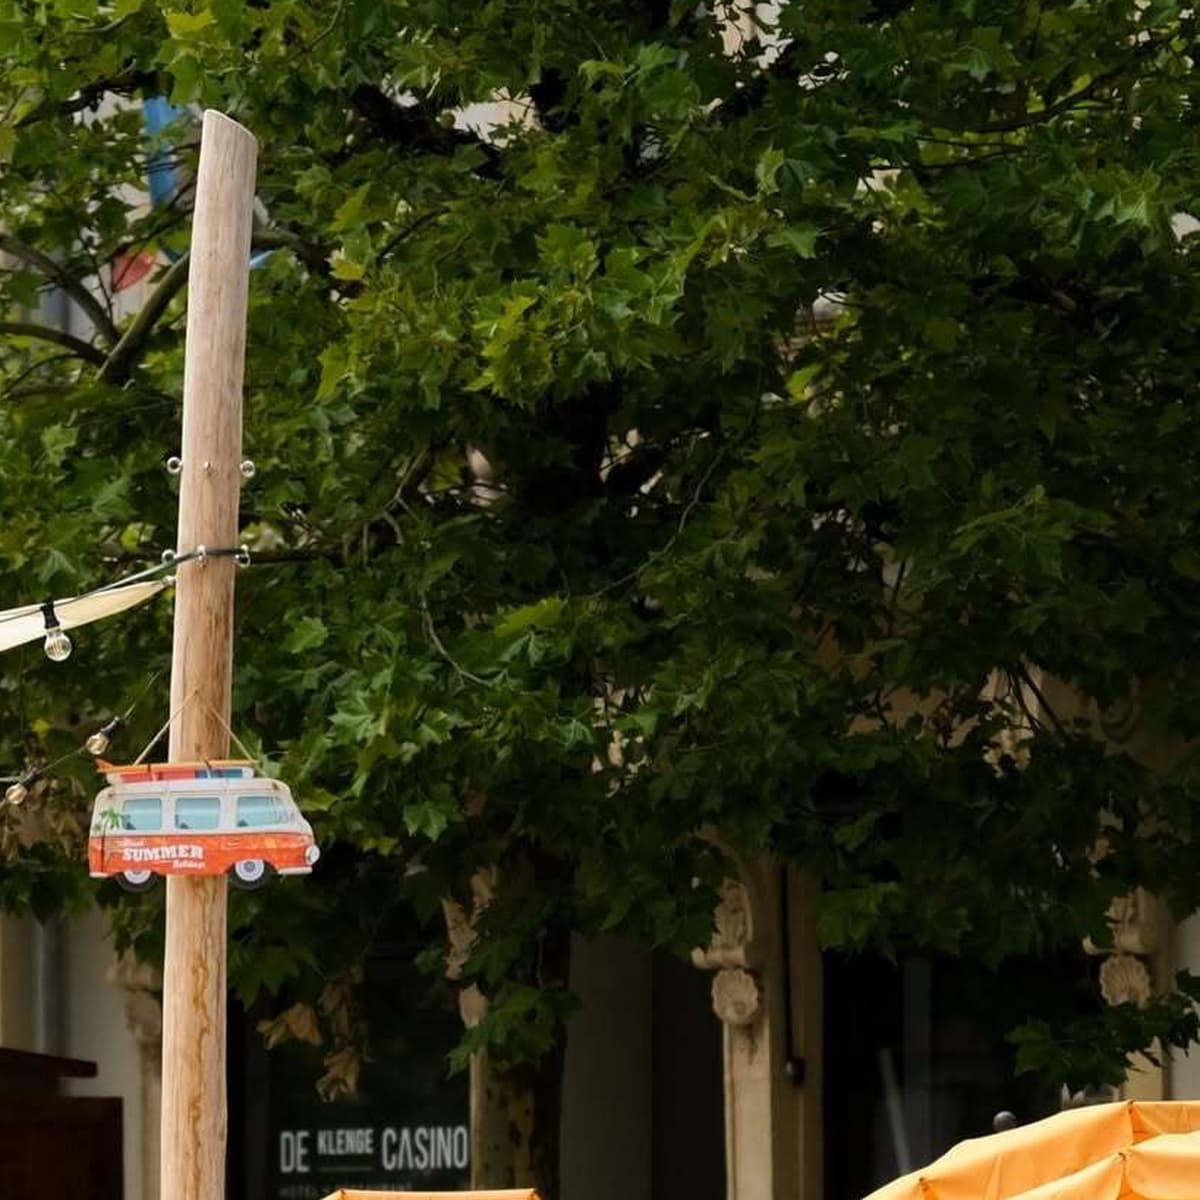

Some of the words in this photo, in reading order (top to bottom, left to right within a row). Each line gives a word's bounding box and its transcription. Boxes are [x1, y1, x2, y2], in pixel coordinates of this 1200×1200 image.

[122, 844, 204, 861] SUMMER
[280, 1130, 310, 1173] DE
[317, 1128, 374, 1154] KLENGE
[381, 1125, 469, 1170] CASINO
